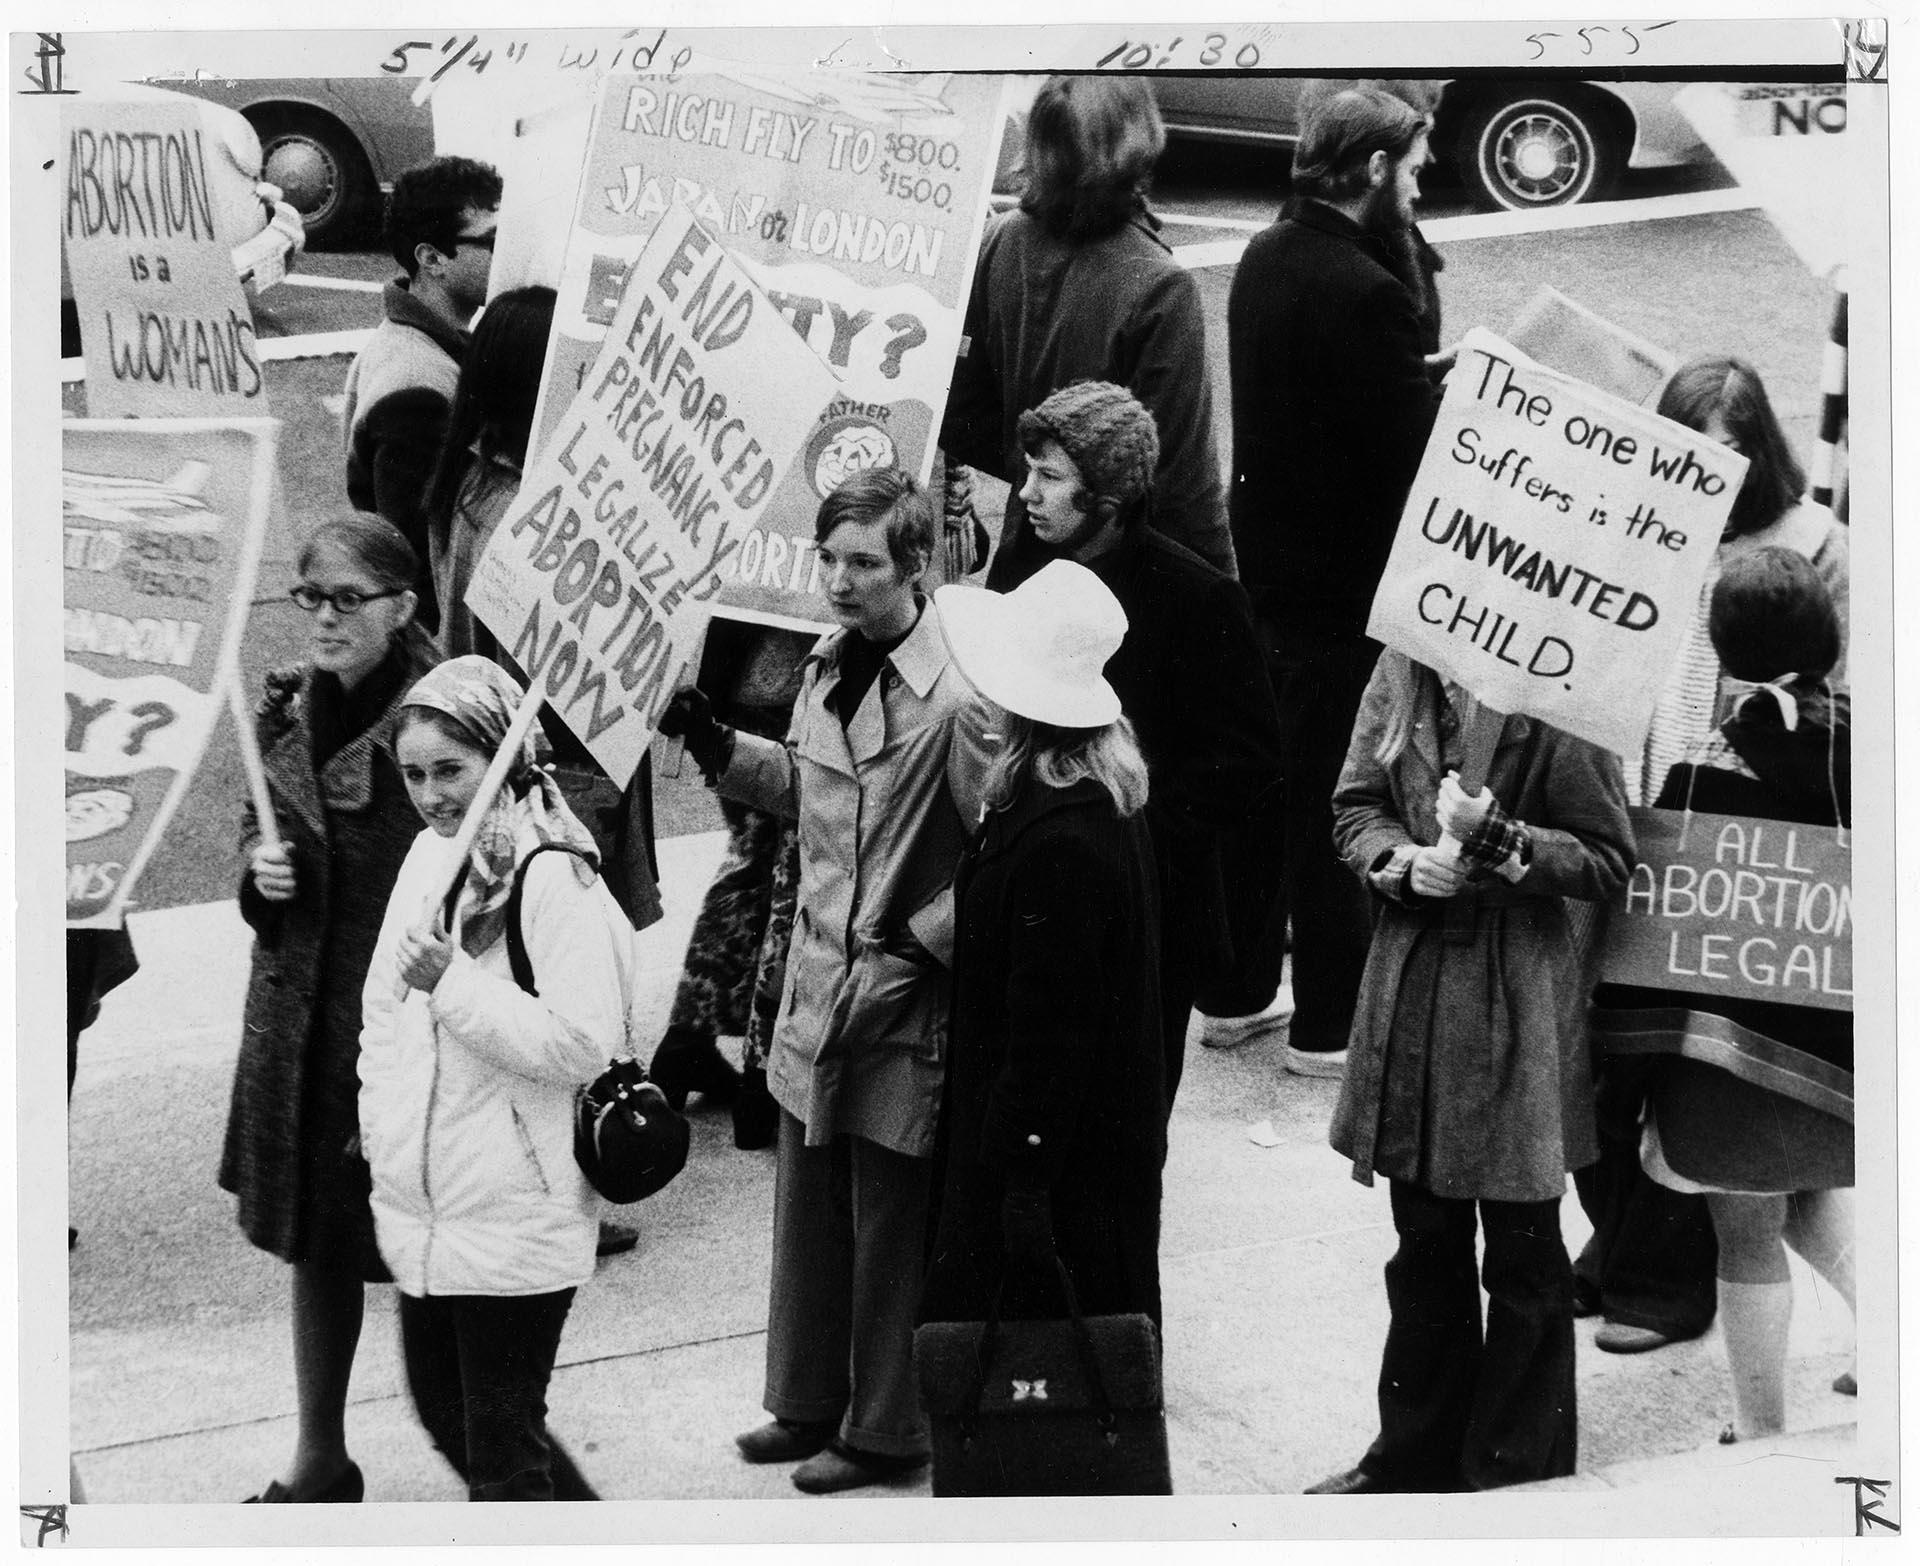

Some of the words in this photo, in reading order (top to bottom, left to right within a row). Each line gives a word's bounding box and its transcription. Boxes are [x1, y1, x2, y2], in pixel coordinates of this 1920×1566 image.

[559, 28, 693, 73] wide
[67, 129, 215, 241] ABORTION
[622, 86, 737, 149] RICH
[742, 106, 818, 164] FLY
[828, 122, 877, 175] TO
[884, 132, 960, 169] $800.
[788, 200, 944, 278] LONDON
[880, 161, 951, 214] $1500.
[129, 255, 150, 283] is
[157, 262, 171, 283] a
[657, 222, 753, 352] END
[106, 309, 262, 399] WOMAN'S
[625, 295, 775, 510] ENFORCED
[1473, 348, 1552, 426] The
[1564, 415, 1638, 465] one
[1650, 444, 1726, 497] who
[558, 421, 690, 616] LEGALIZE
[1451, 428, 1574, 513] Suffers
[1588, 494, 1607, 526] is
[1625, 503, 1688, 552] the
[511, 484, 688, 731] ABORTION
[1421, 497, 1659, 632] UNWANTED
[512, 599, 626, 745] NOW
[1418, 583, 1574, 691] CHILD.
[1715, 822, 1814, 874] ALL
[1668, 931, 1854, 996] LEGAL
